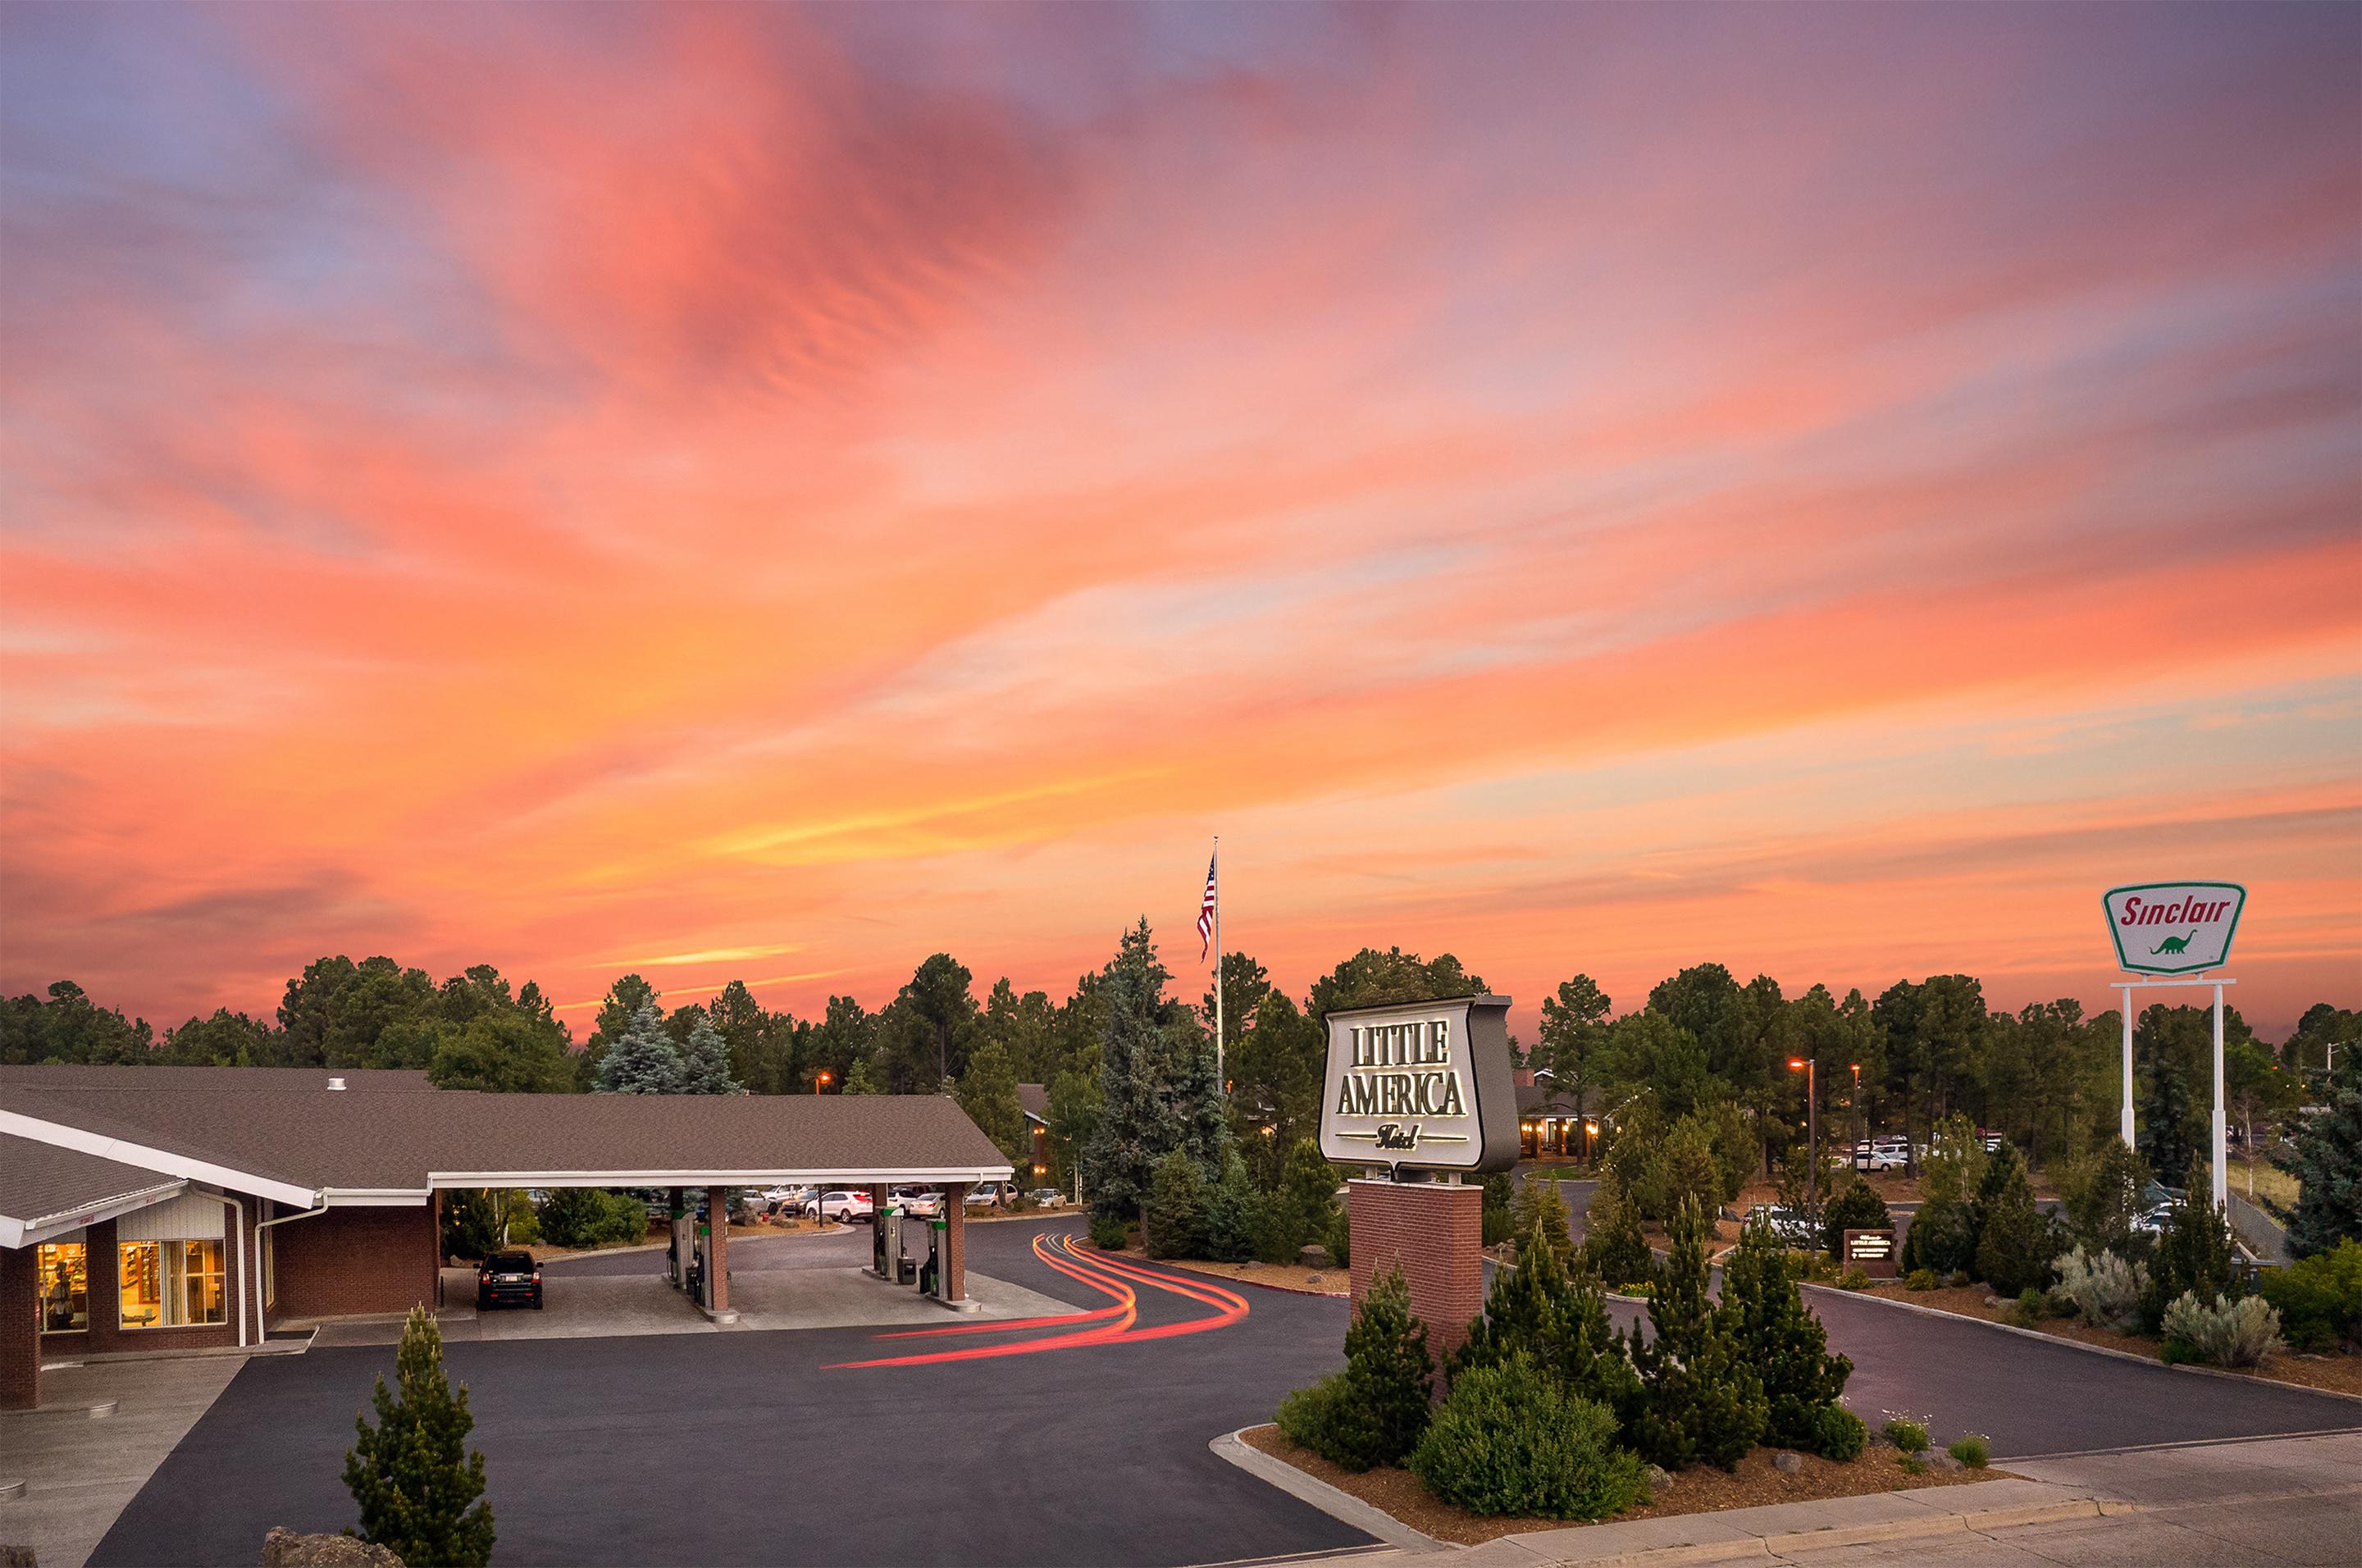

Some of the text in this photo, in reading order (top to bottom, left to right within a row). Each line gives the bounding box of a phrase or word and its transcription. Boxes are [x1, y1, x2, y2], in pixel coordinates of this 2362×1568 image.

[2121, 895, 2231, 925] Sinclair
[1350, 1021, 1448, 1068] LITTLE
[1335, 1072, 1466, 1115] AMERICA
[1375, 1124, 1419, 1149] Hotel
